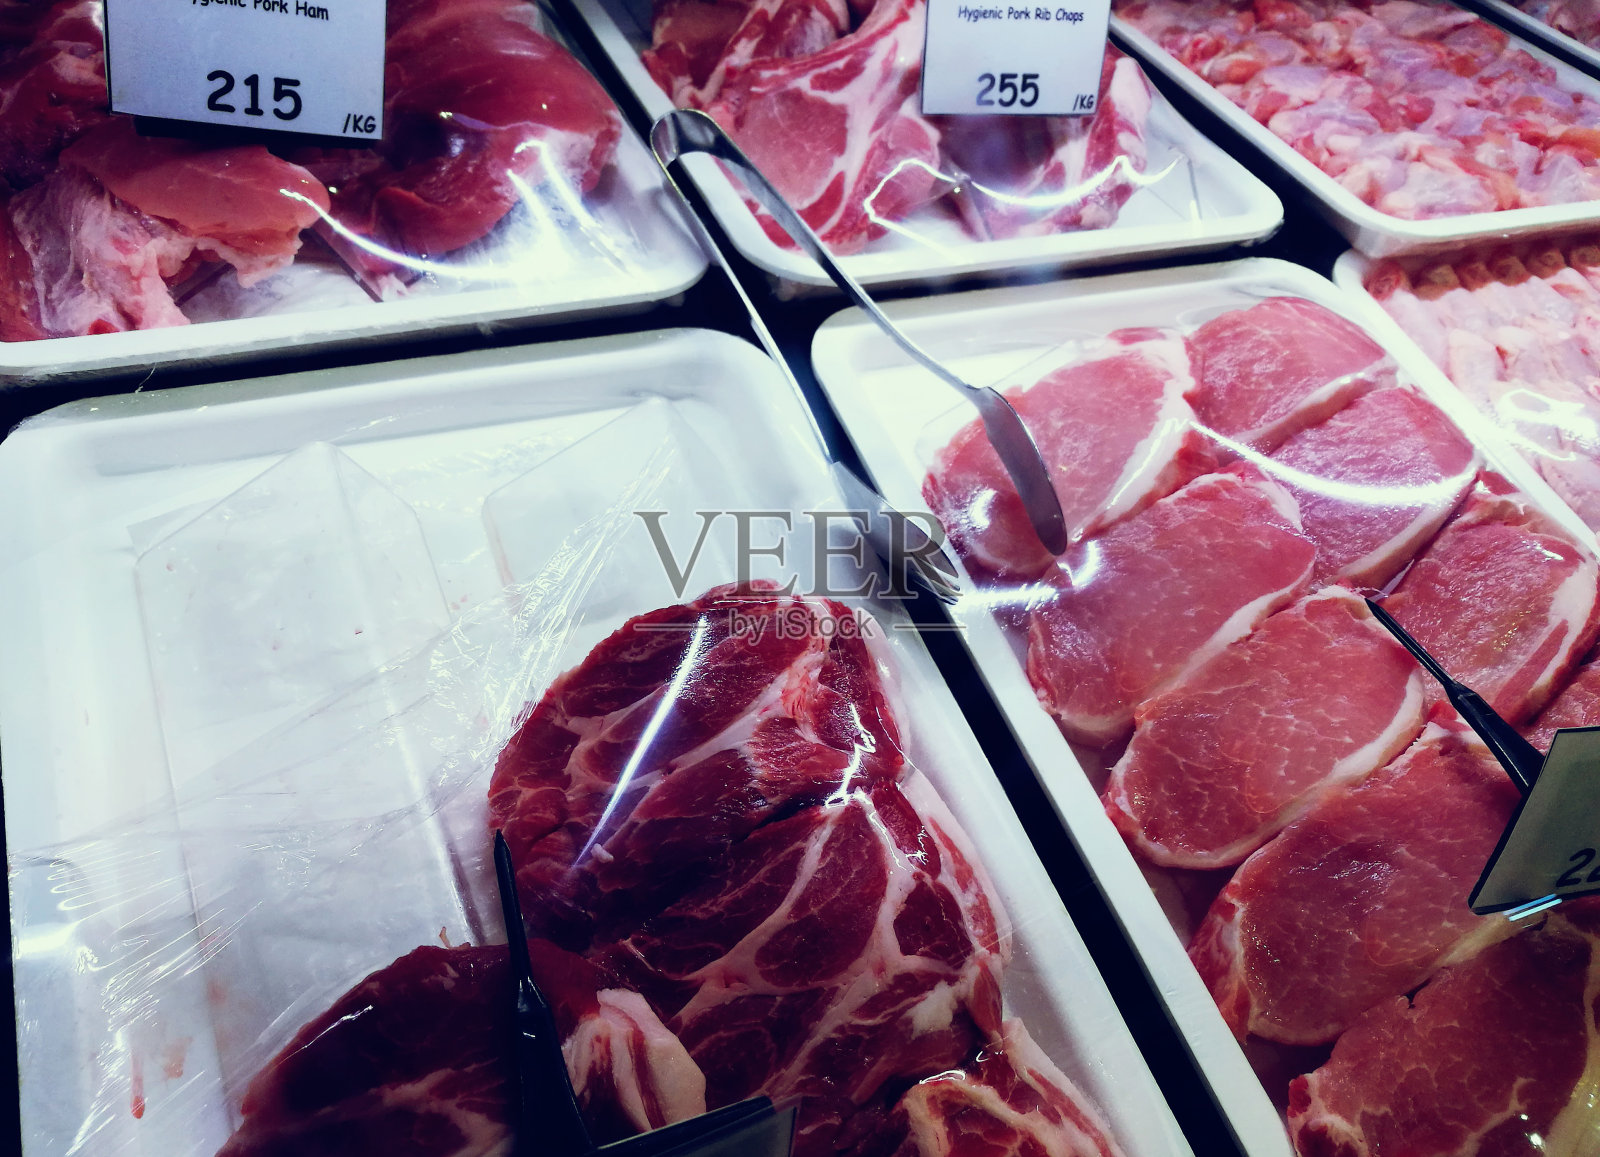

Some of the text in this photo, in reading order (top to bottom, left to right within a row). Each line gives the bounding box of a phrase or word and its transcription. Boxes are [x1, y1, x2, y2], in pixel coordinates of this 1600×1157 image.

[253, 0, 288, 14] Pork
[295, 0, 329, 21] Ham
[958, 5, 1084, 24] Hygienic Pork Rib Chops
[206, 69, 303, 121] 215
[975, 73, 1040, 108] 255
[1072, 95, 1095, 111] /KG
[342, 113, 377, 134] /KG
